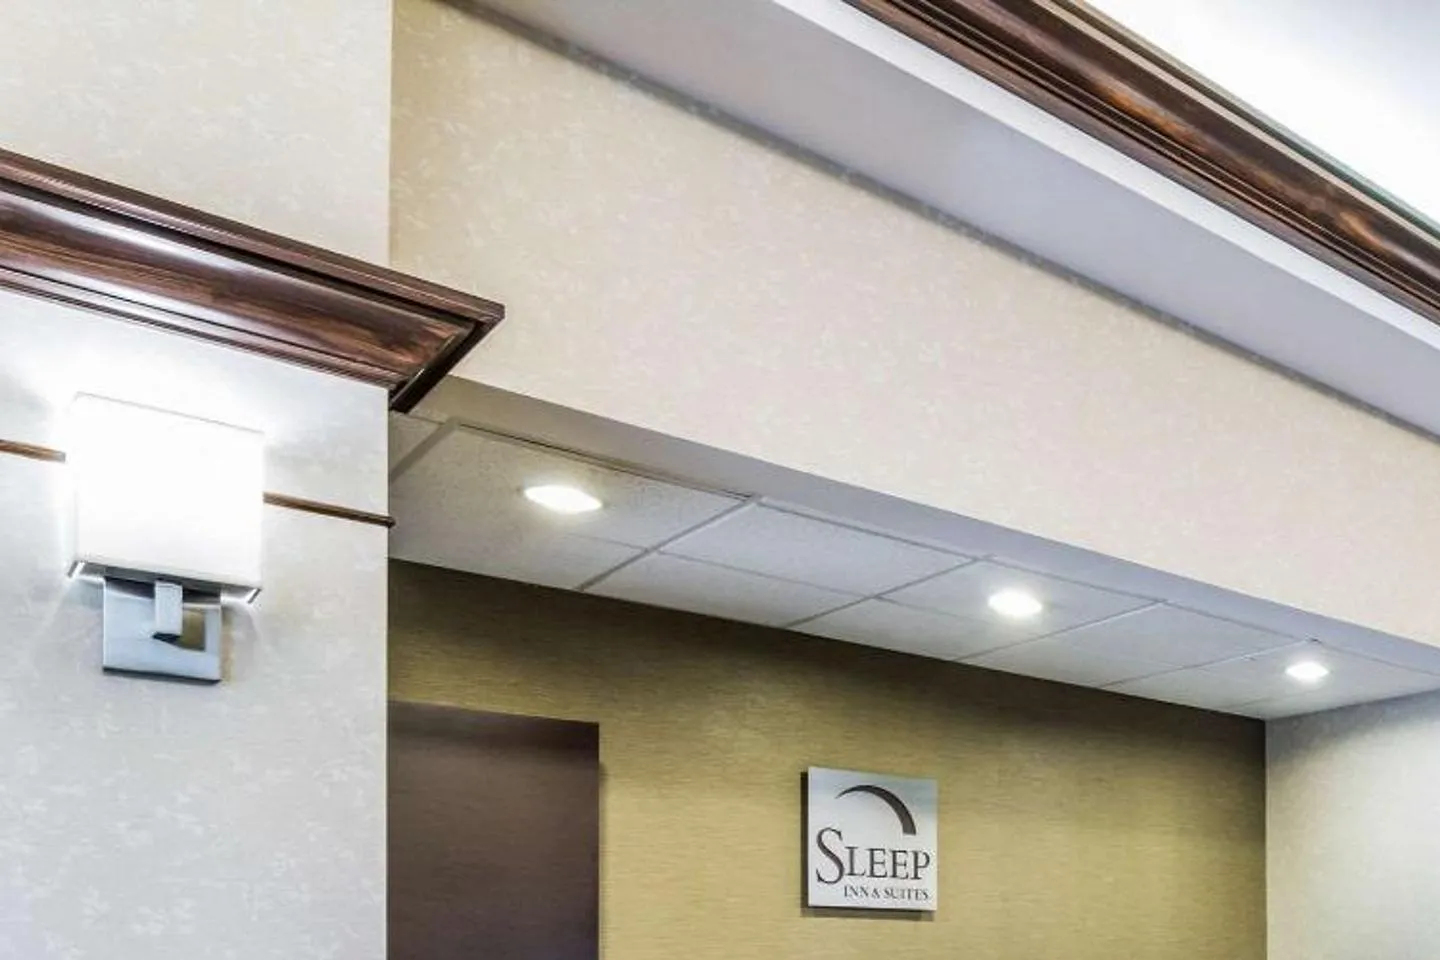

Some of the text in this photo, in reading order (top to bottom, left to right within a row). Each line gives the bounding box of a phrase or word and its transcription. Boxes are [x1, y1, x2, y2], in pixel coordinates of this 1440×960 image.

[815, 826, 931, 885] SLEEP
[843, 884, 930, 900] INN & SUITES
